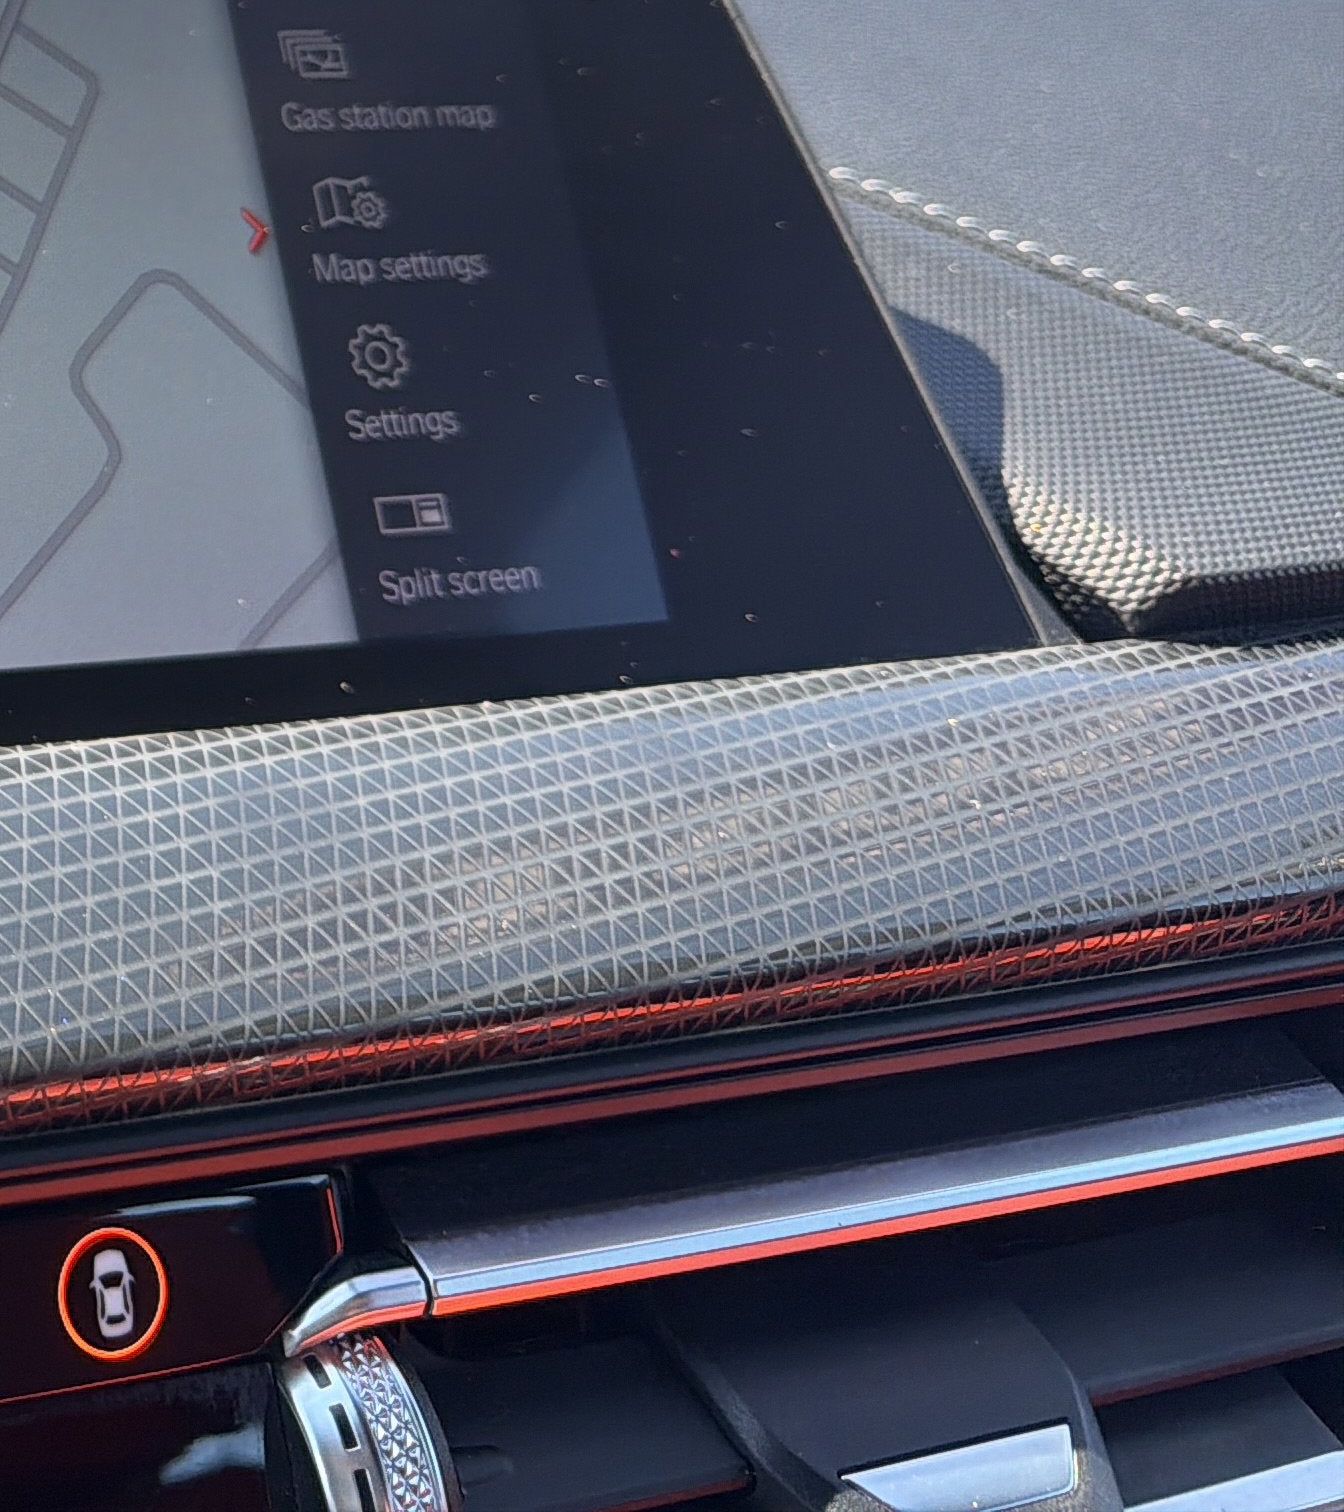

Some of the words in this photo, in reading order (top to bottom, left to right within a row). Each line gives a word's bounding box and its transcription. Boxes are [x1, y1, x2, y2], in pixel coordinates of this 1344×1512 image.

[280, 101, 335, 133] Gas
[338, 103, 431, 131] station
[435, 105, 498, 131] map
[312, 253, 374, 285] Map
[380, 251, 490, 284] settings
[345, 407, 463, 442] Settings
[378, 569, 444, 606] Split
[447, 564, 543, 594] screen
